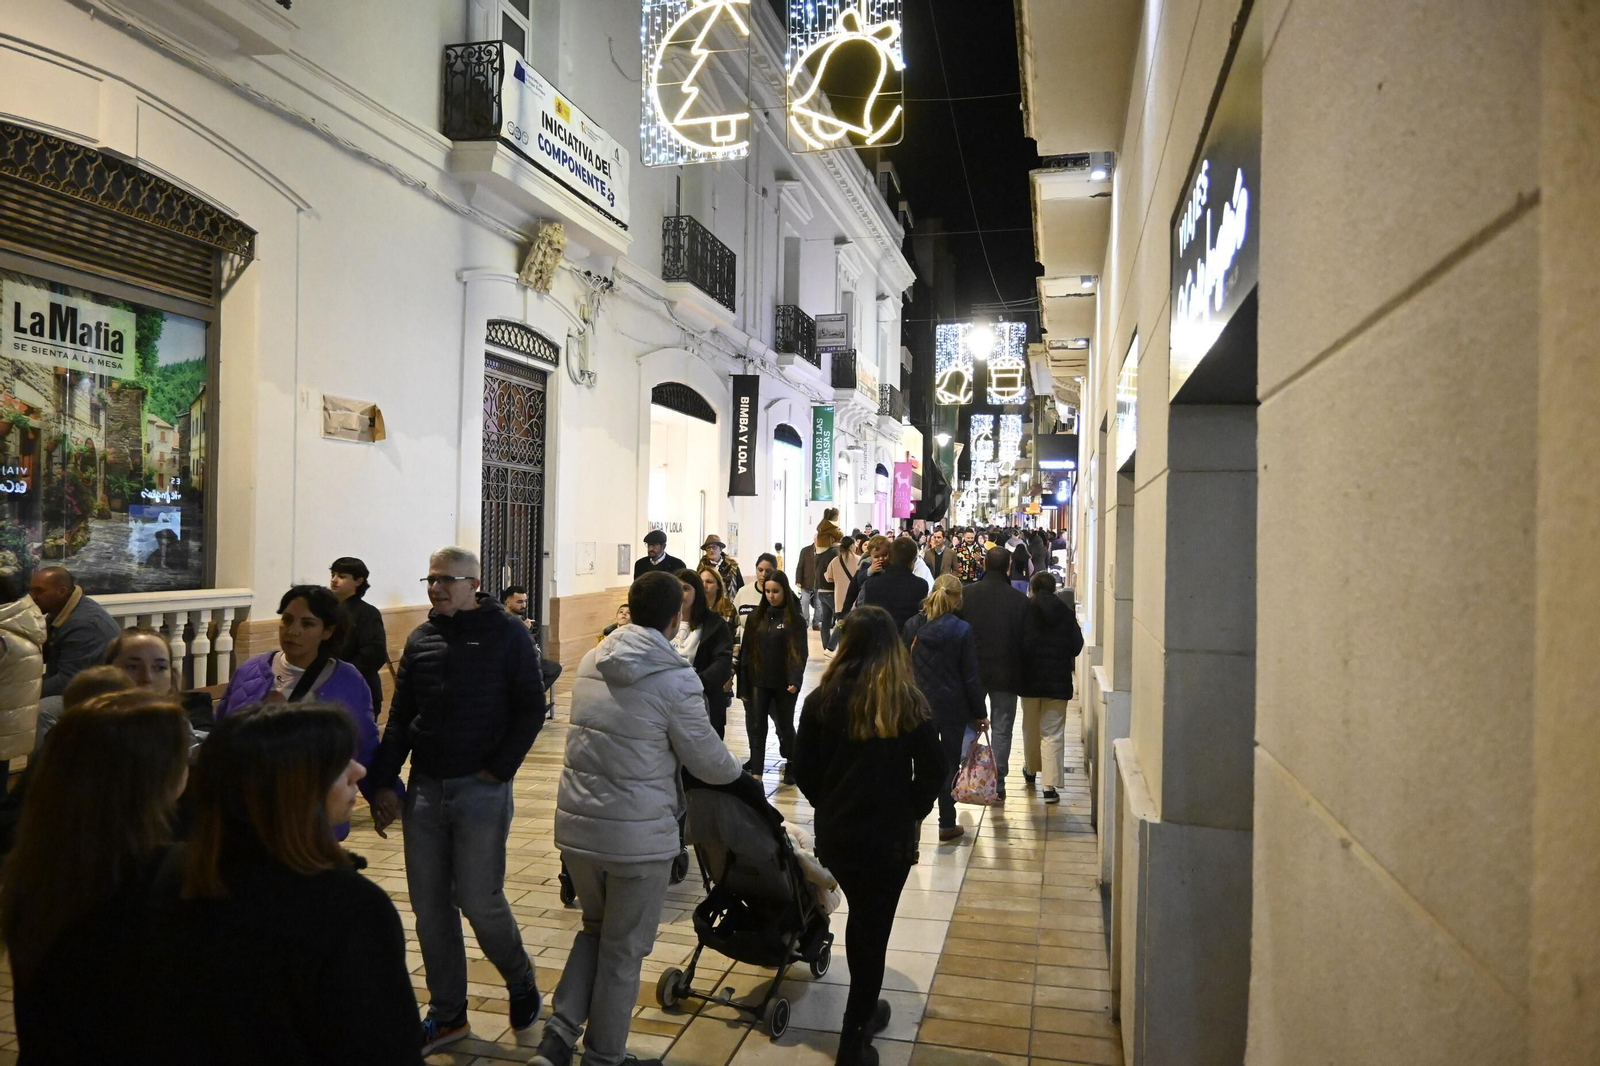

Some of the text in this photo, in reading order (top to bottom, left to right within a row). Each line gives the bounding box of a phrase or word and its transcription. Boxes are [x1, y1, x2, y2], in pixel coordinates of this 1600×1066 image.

[541, 110, 594, 166] INICIATIVA
[538, 133, 606, 197] COMPONENTE
[1178, 159, 1209, 258] VIAJES
[13, 342, 123, 370] SE SIENTA A LA MESA
[737, 396, 750, 475] BIMBA Y LOLA
[816, 437, 823, 450] DE
[823, 430, 831, 477] CARCASAS
[815, 450, 823, 474] CASA
[815, 475, 822, 489] LA
[665, 522, 669, 532] Y
[669, 522, 682, 533] LOLA
